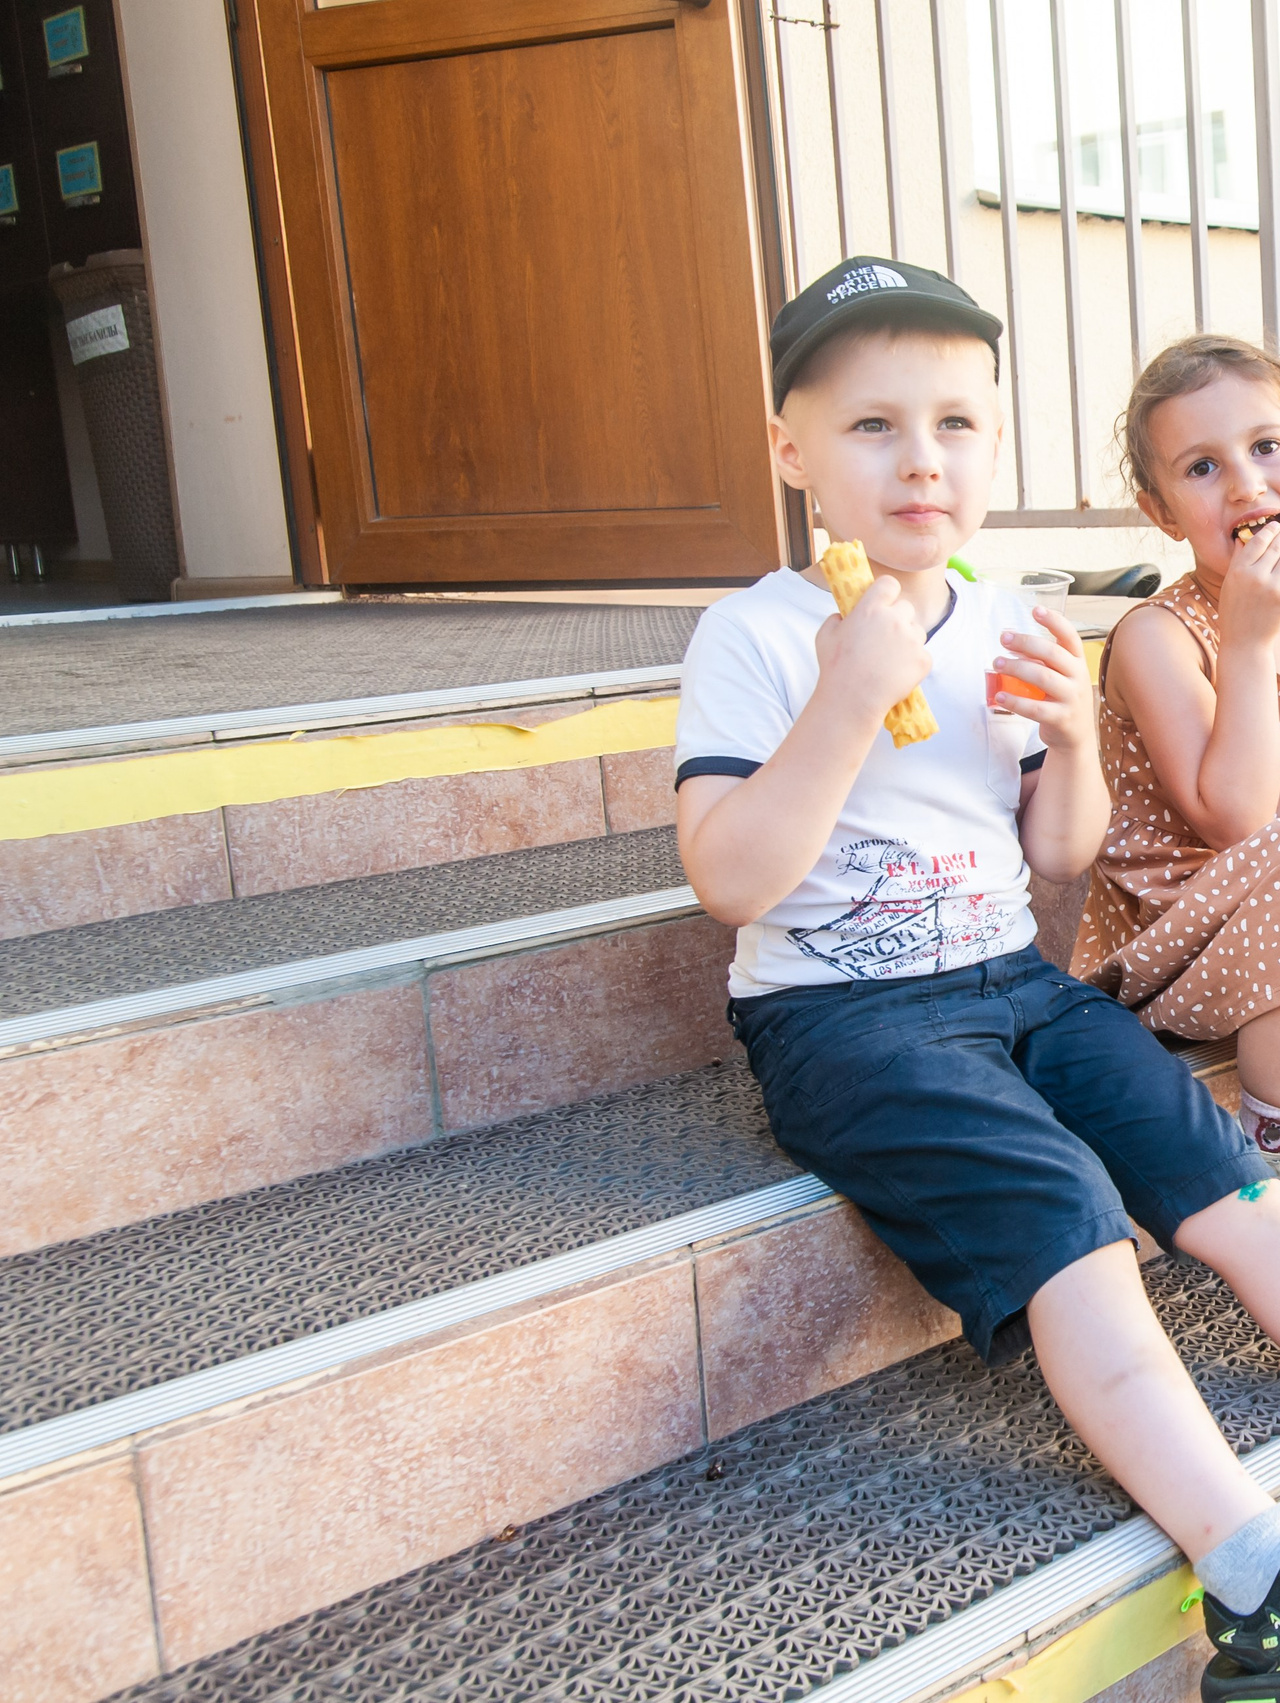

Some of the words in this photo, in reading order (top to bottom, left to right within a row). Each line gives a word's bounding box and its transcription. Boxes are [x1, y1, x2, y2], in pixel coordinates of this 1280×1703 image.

[843, 266, 874, 280] THE
[826, 273, 877, 301] NORTH
[838, 281, 879, 300] FACE
[840, 837, 908, 854] CALIFORNIA
[930, 851, 978, 875] 1981
[873, 917, 888, 930] ACT
[843, 916, 935, 966] INCITY
[873, 962, 892, 978] LOS
